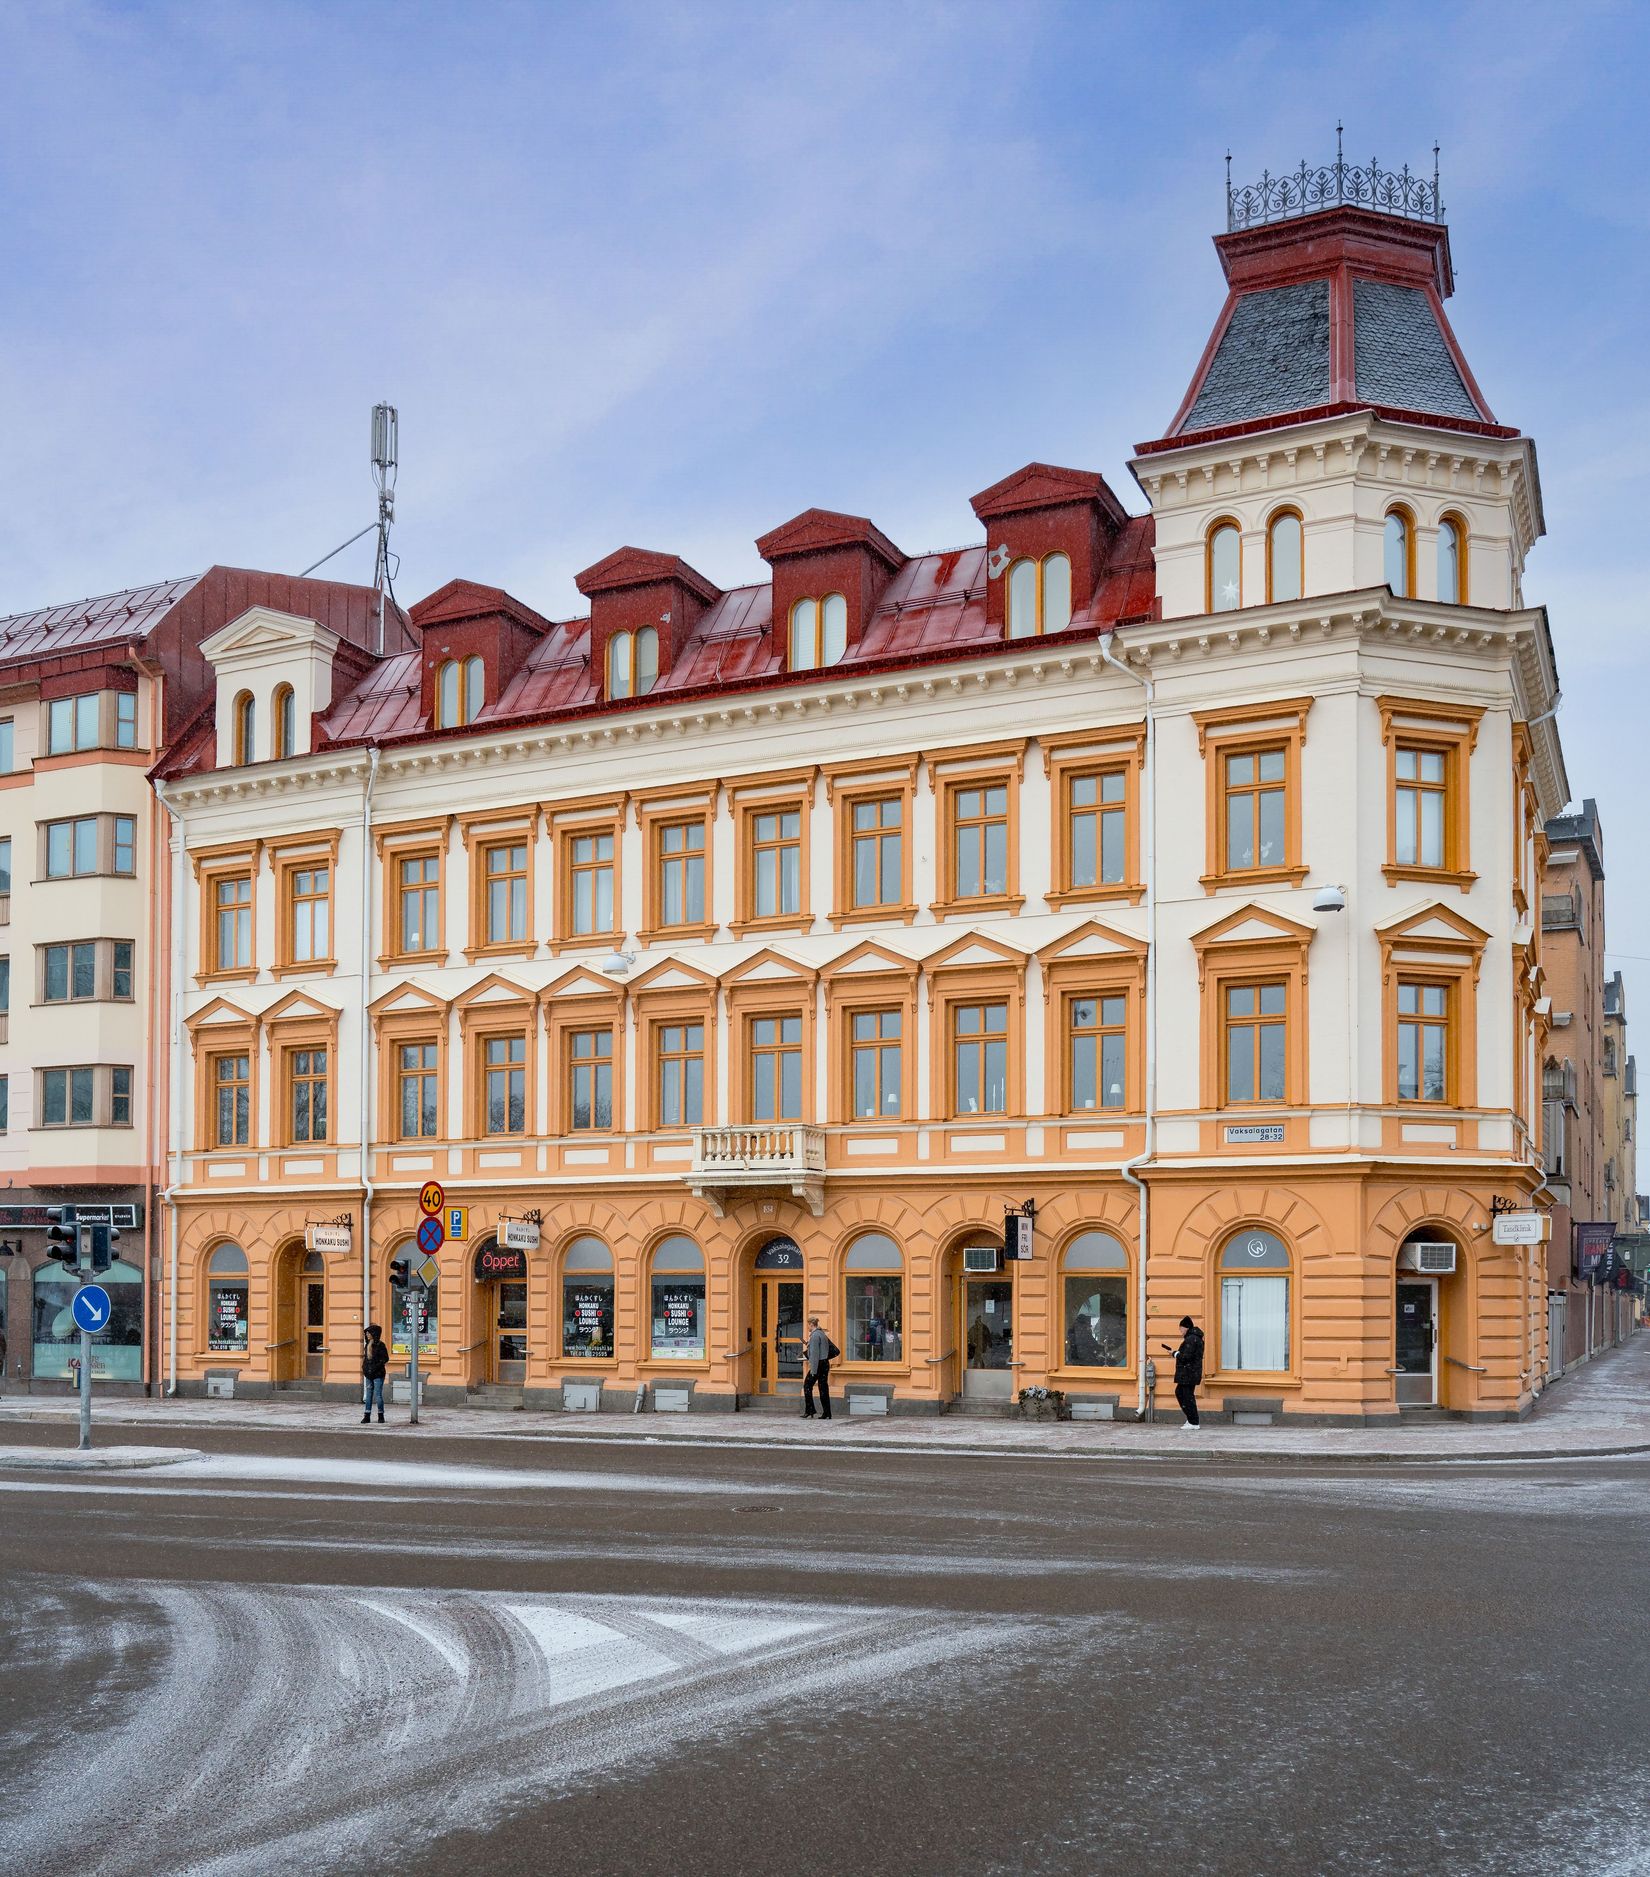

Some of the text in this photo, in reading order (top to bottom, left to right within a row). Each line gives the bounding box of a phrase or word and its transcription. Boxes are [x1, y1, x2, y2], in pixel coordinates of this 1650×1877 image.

[423, 1190, 440, 1207] 40
[75, 1213, 110, 1221] Supermarket
[1502, 1224, 1531, 1232] Tandklinik
[315, 1237, 349, 1247] HONKAKU SUSHI
[508, 1233, 538, 1243] HONKAKU SUSHI
[482, 1251, 519, 1269] Öppet
[777, 1254, 789, 1264] 32
[68, 1358, 81, 1368] ICA
